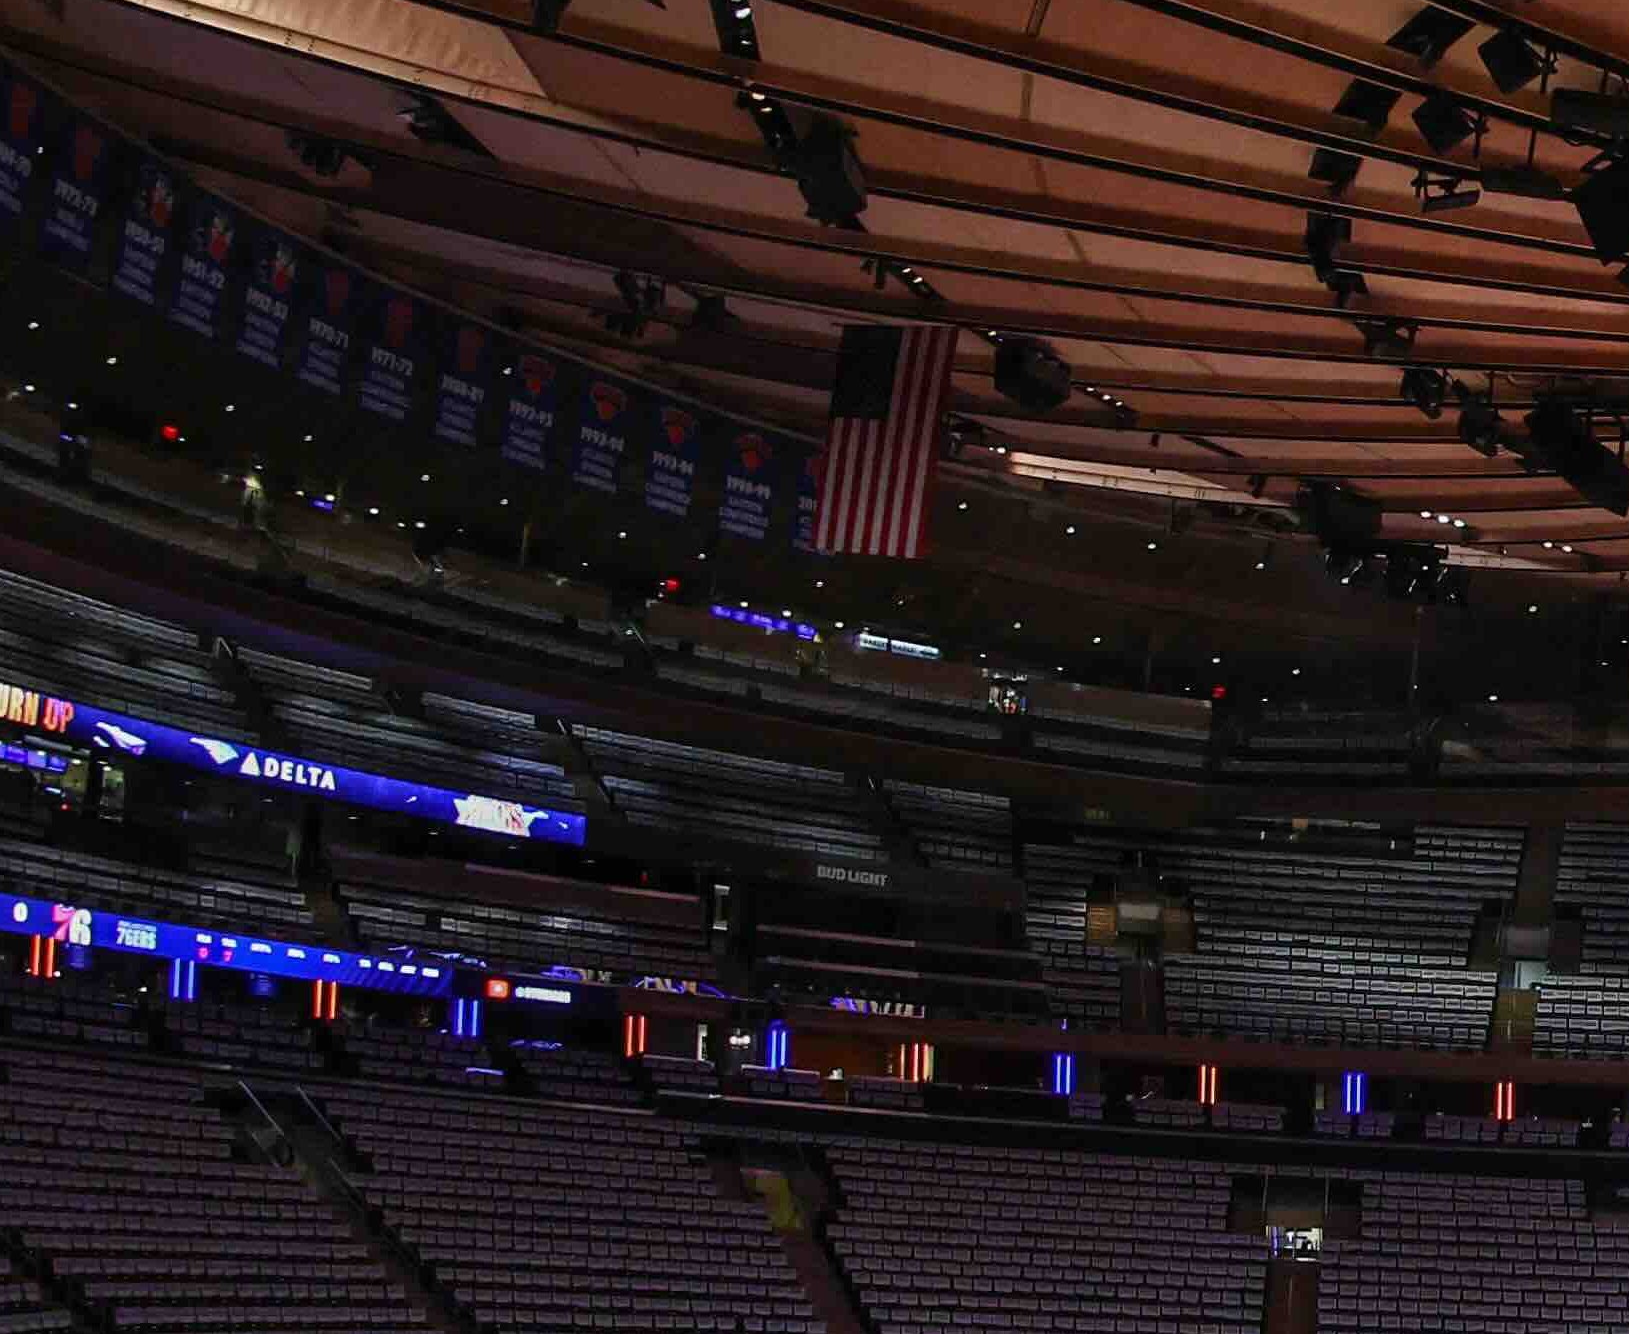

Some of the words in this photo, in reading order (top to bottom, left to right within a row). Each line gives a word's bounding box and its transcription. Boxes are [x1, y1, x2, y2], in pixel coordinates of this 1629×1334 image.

[0, 682, 39, 726] URN
[43, 697, 75, 734] UP
[263, 756, 337, 792] DELTA
